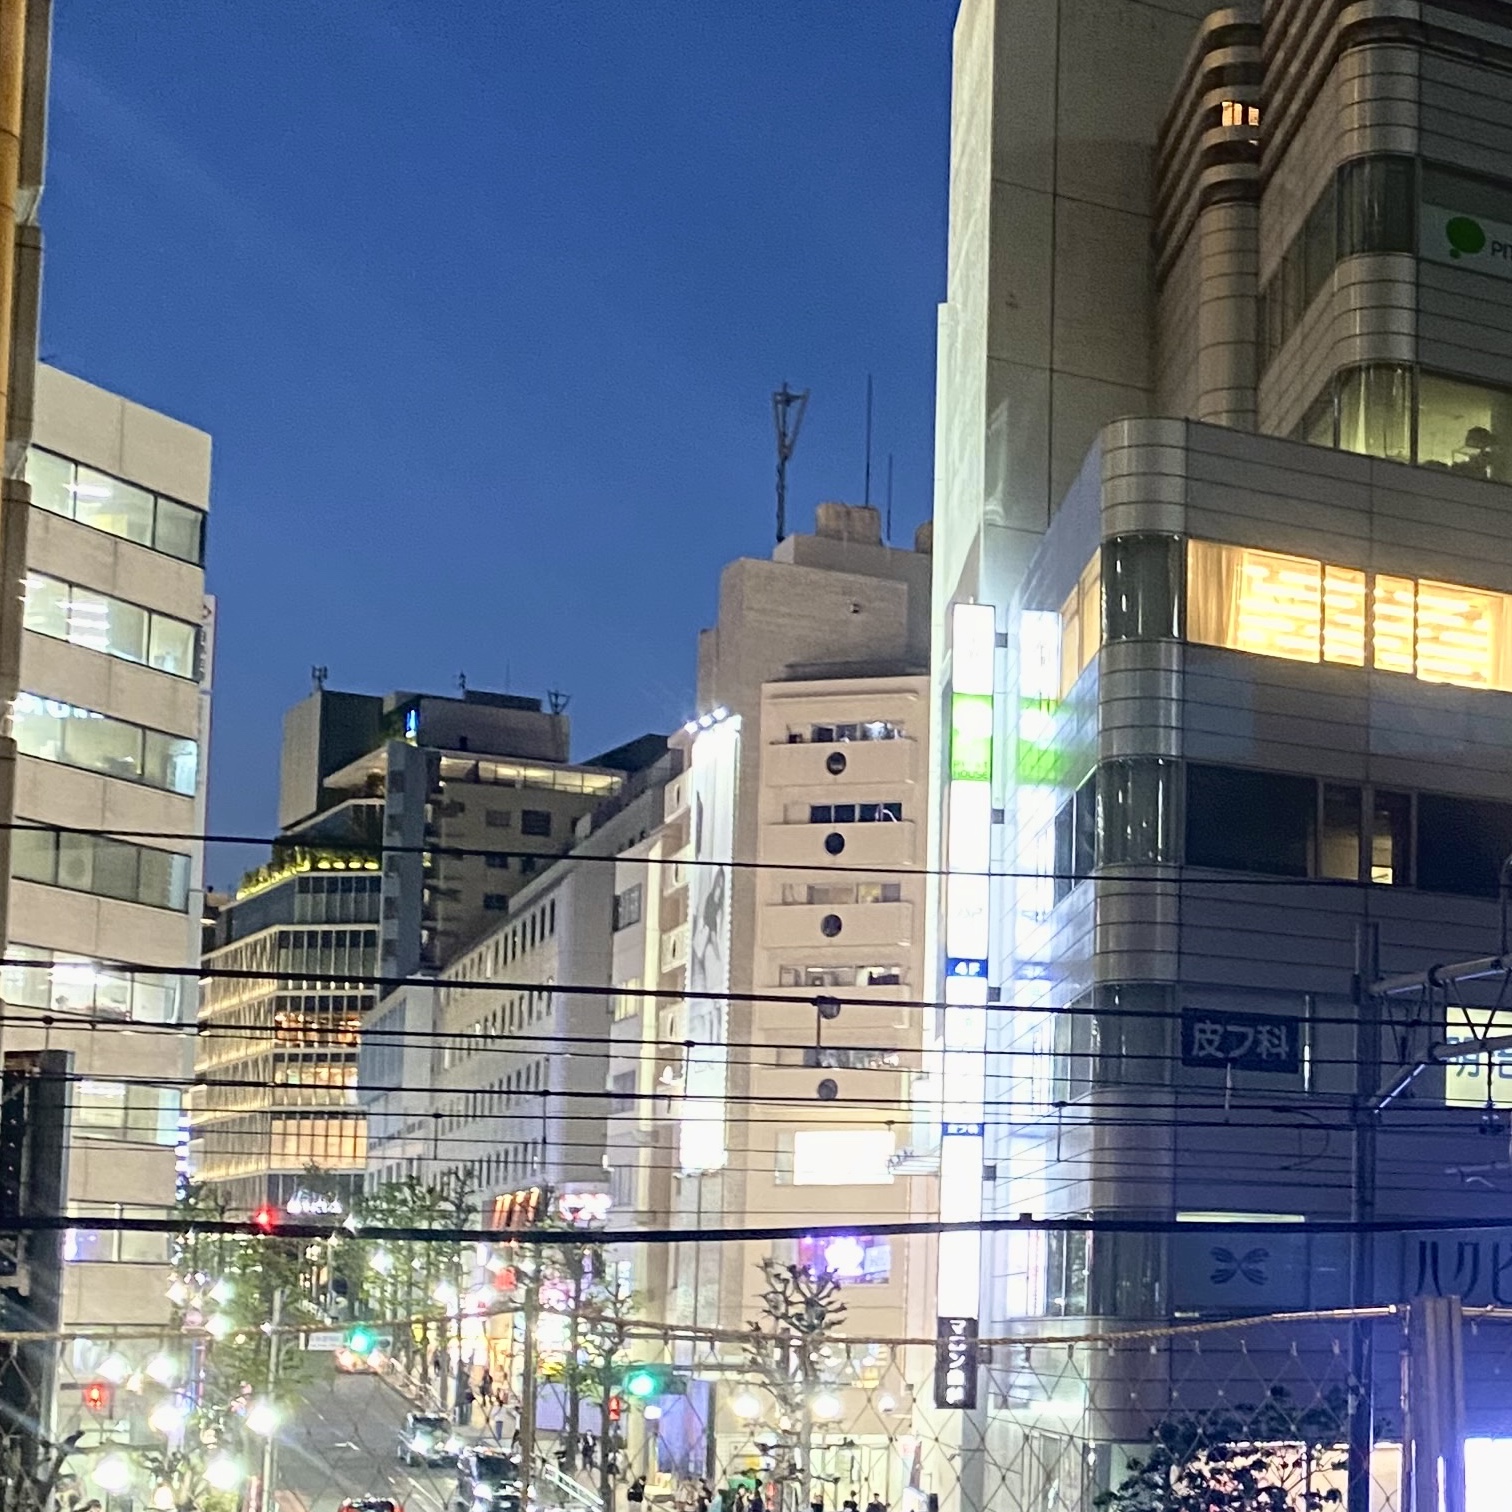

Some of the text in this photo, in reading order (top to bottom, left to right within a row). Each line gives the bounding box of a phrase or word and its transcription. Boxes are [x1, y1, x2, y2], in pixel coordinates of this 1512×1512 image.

[954, 961, 981, 976] 4F
[1192, 1020, 1289, 1059] 皮フ科
